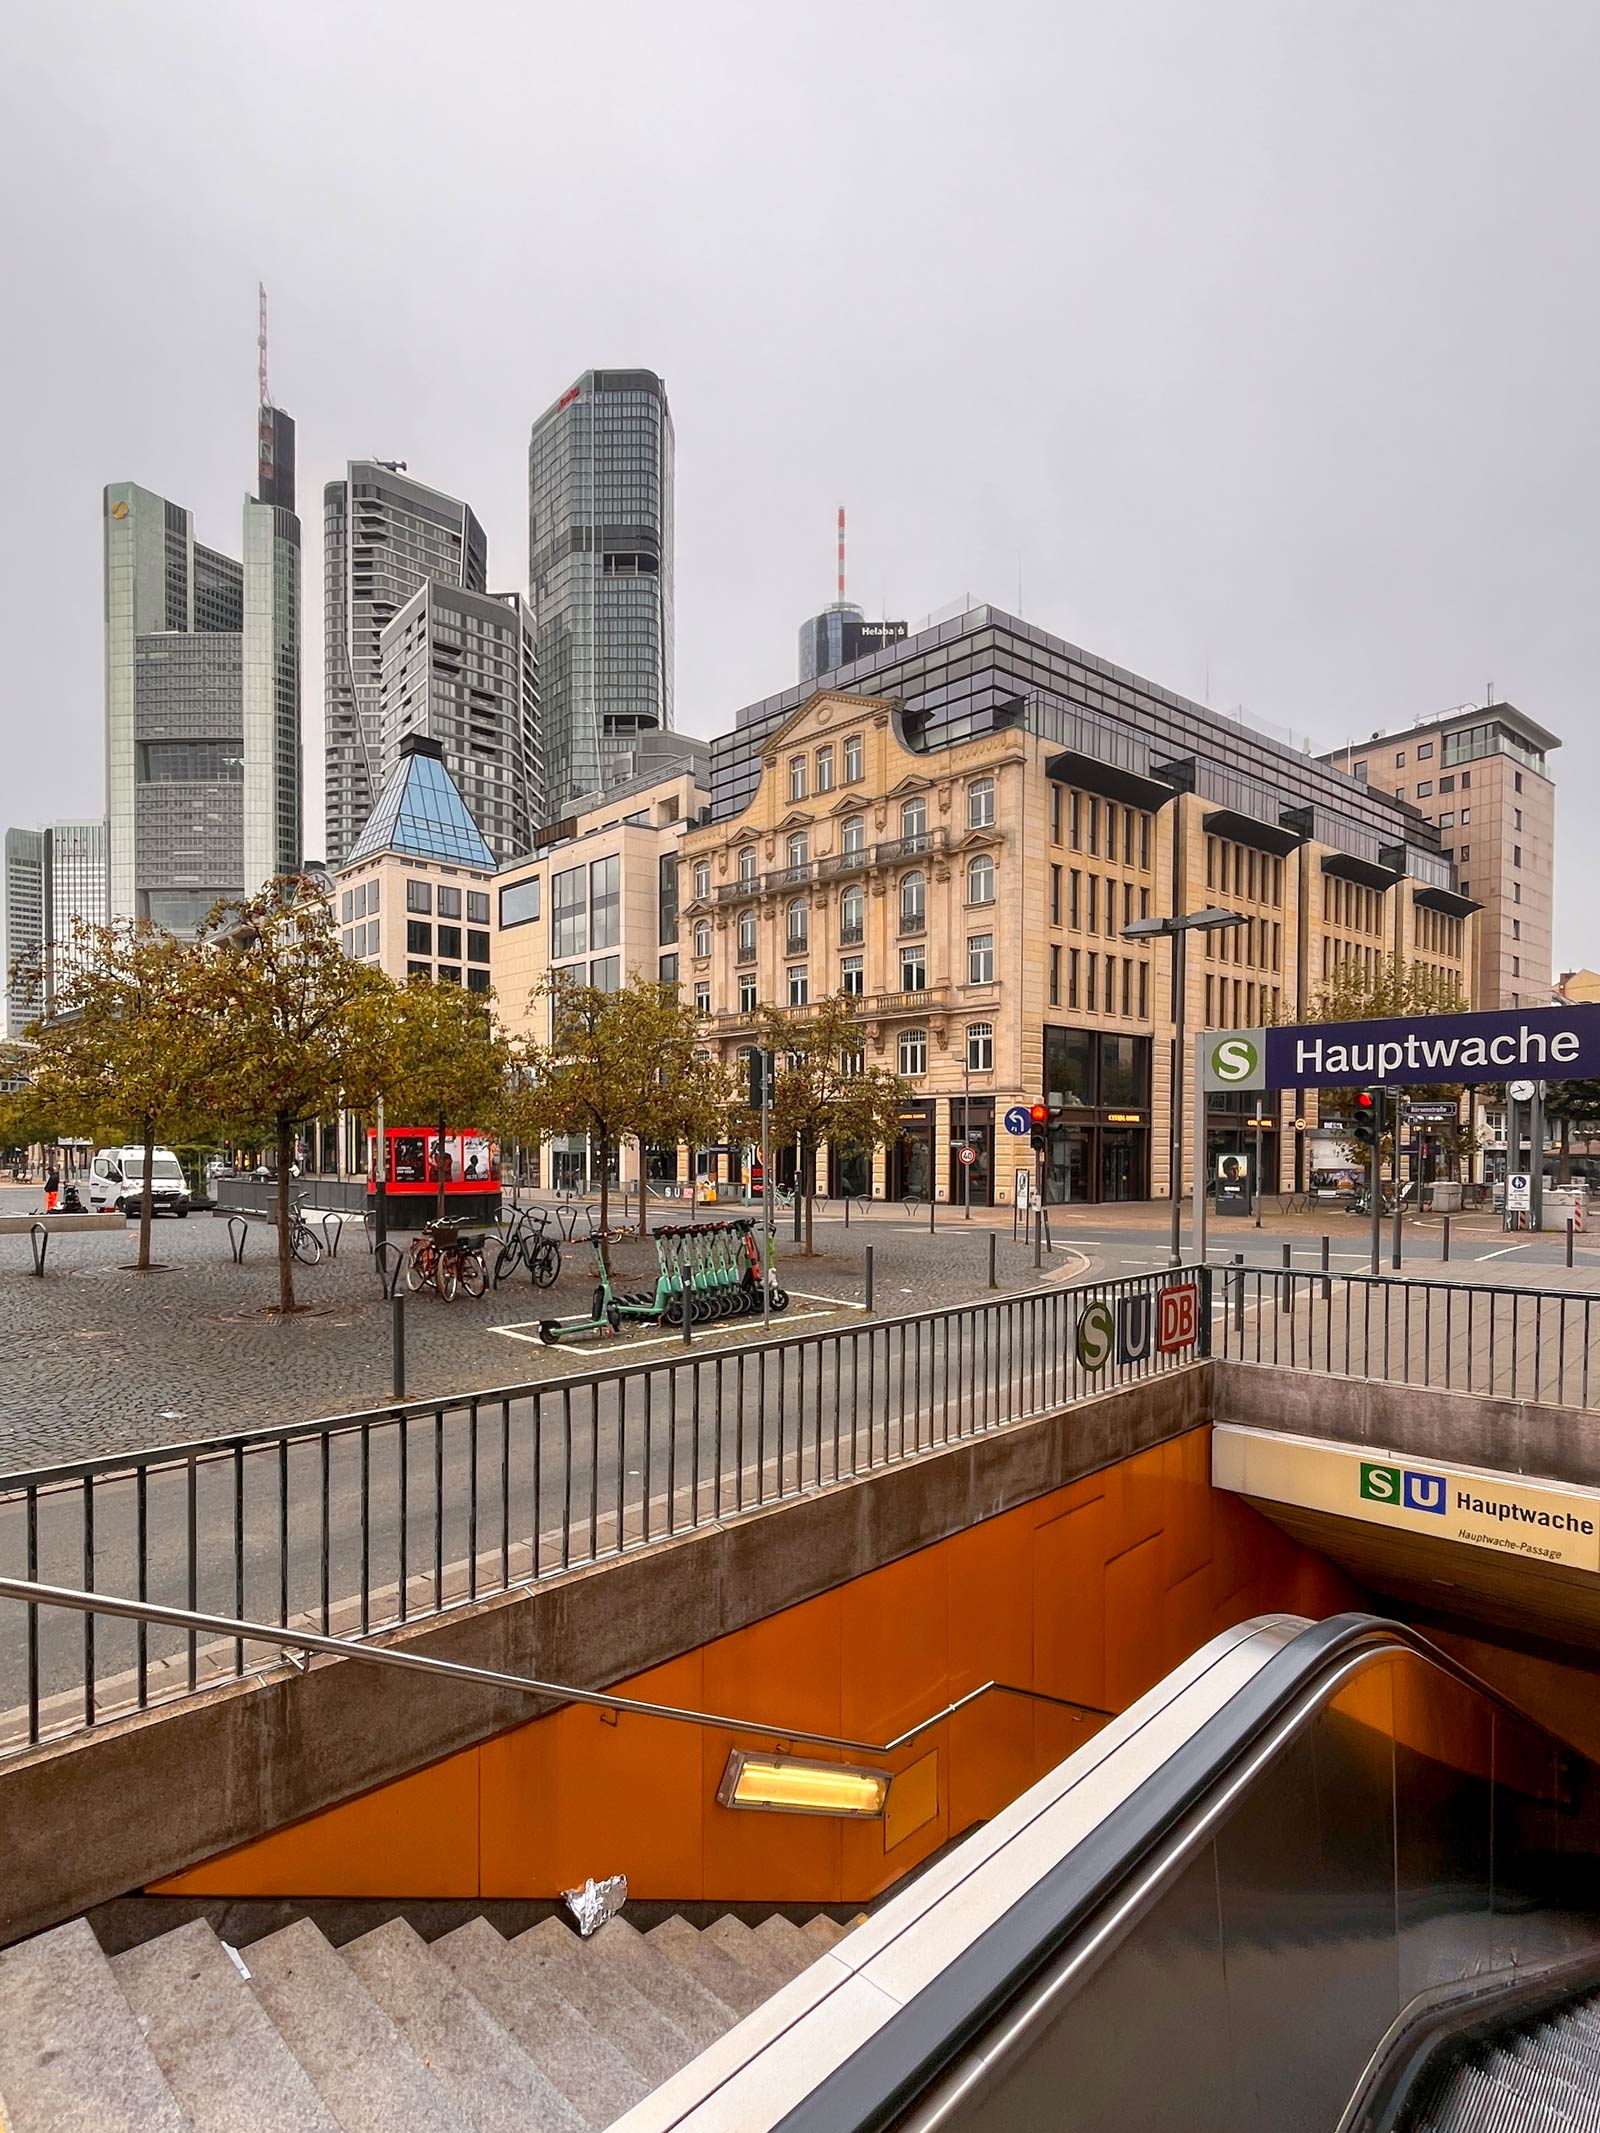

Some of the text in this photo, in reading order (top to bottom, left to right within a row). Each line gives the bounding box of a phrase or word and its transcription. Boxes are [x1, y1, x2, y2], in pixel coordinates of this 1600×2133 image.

[862, 626, 894, 636] Helaba
[1217, 1025, 1580, 1080] S Hauptwache
[963, 1152, 972, 1160] 40
[664, 1187, 672, 1198] S
[674, 1187, 681, 1198] U
[1084, 1294, 1193, 1367] S U DB
[1368, 1469, 1594, 1535] S U Hauptwache
[1458, 1528, 1562, 1560] Hauptwache-Passage
